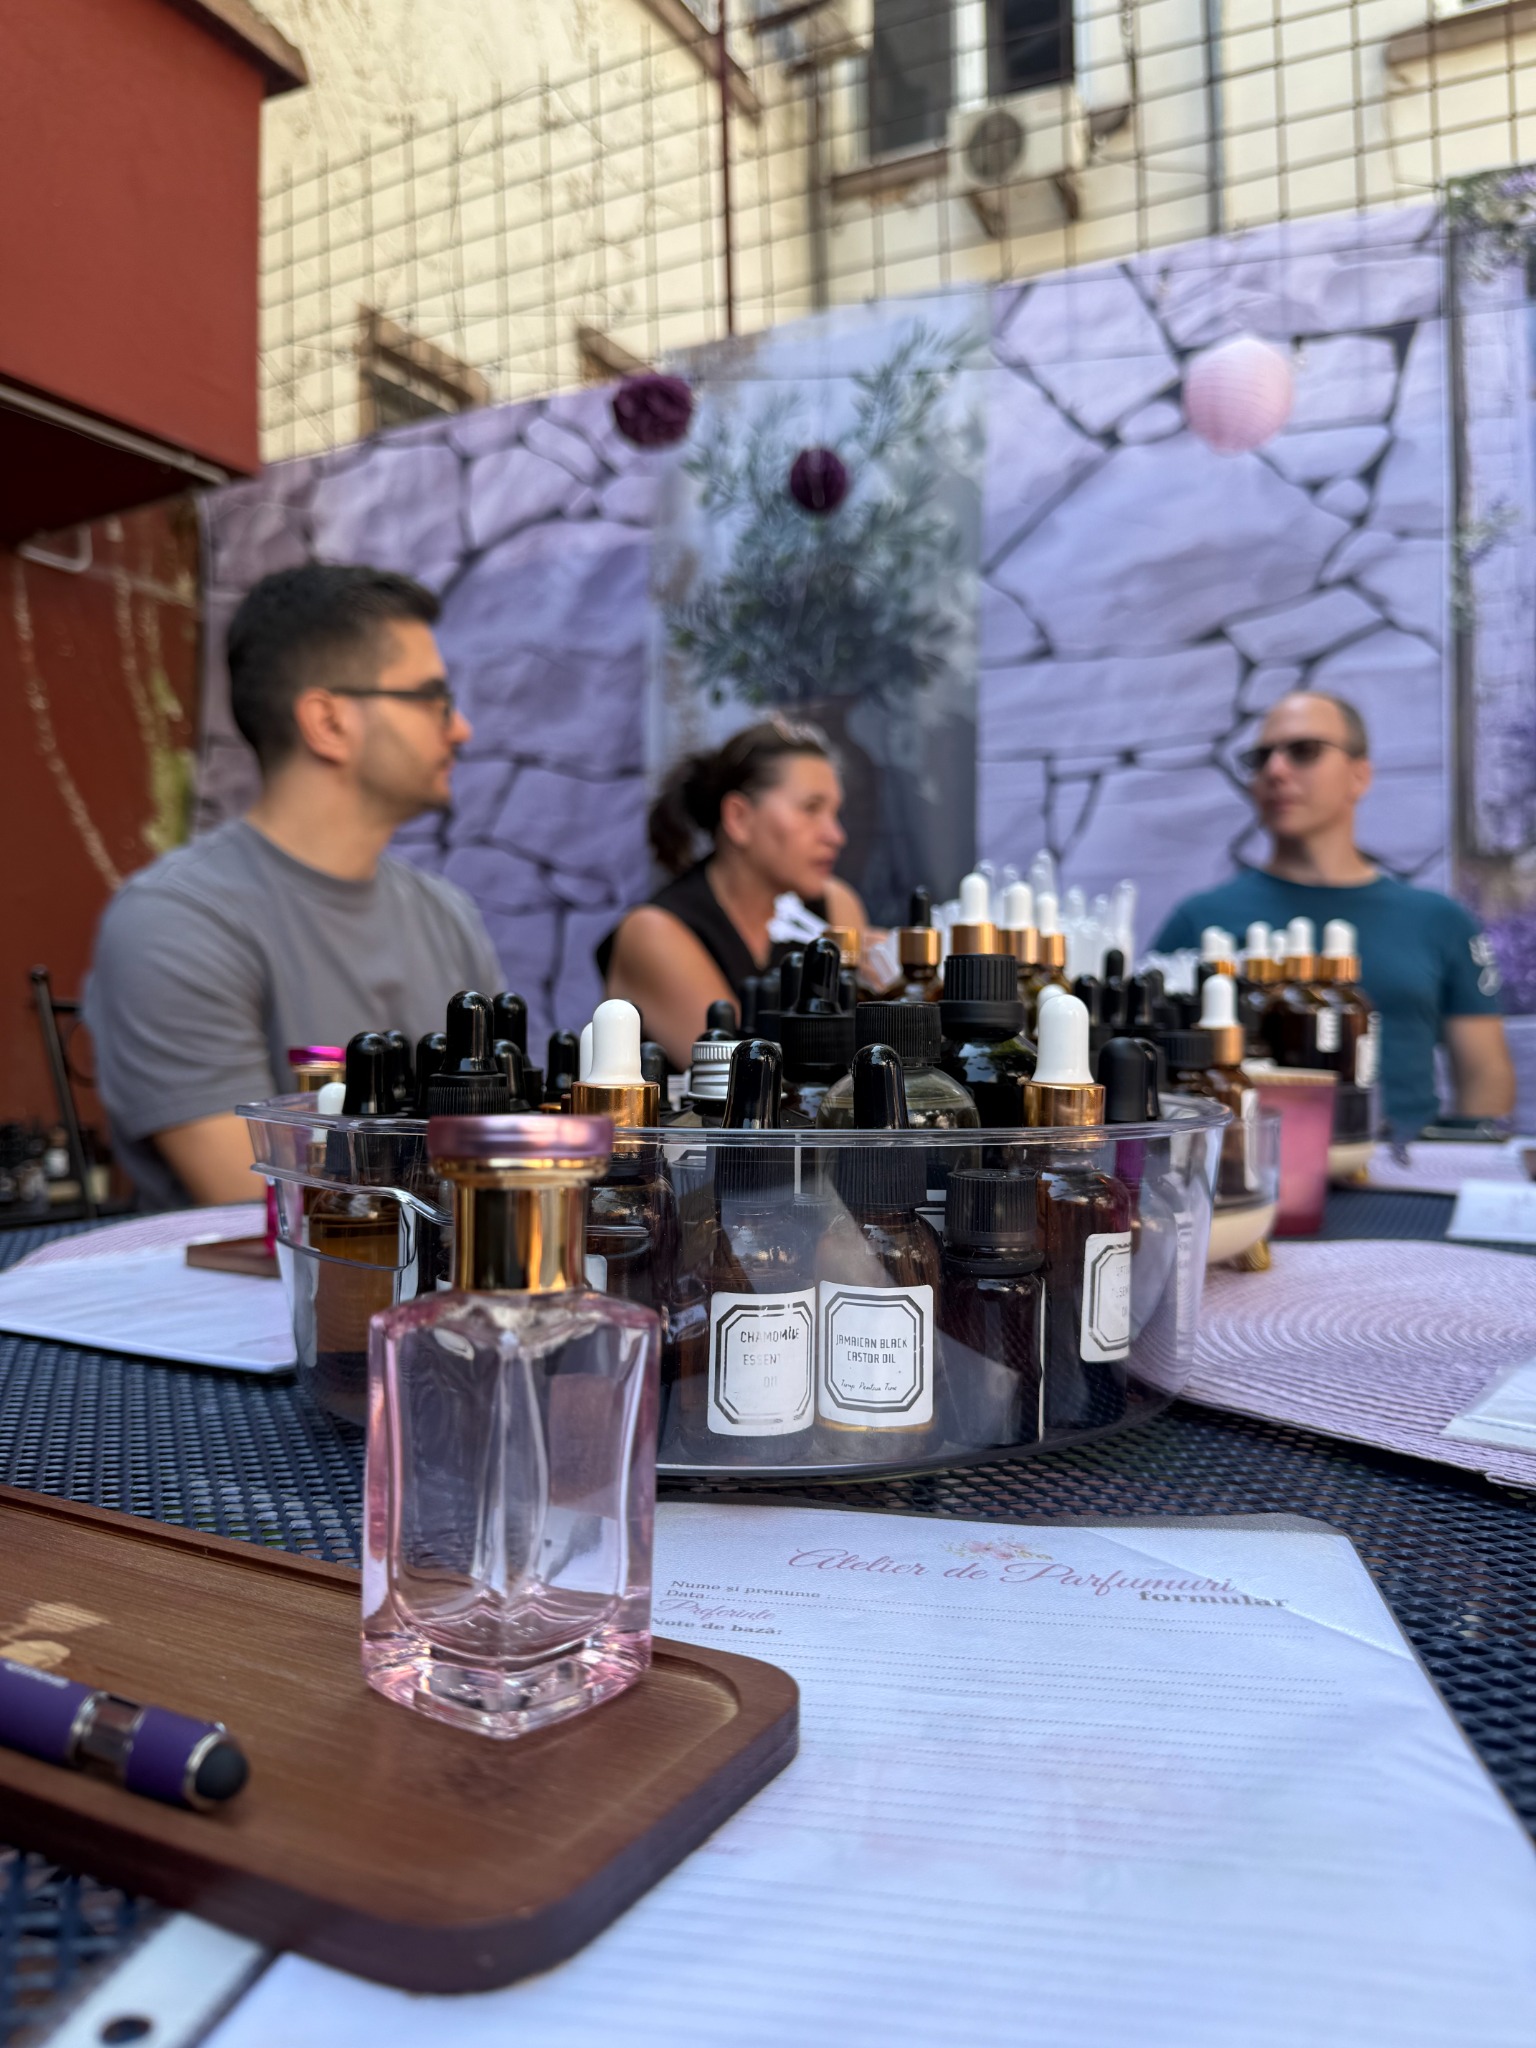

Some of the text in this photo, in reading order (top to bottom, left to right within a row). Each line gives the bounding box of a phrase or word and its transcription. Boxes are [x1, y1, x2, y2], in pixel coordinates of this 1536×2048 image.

[836, 1334, 908, 1349] JAMAICAN BLACK
[847, 1351, 896, 1364] CASTOR OIL
[788, 1548, 1236, 1596] Atelier de Parfumuri
[671, 1580, 721, 1590] Nume
[744, 1587, 821, 1599] prenume
[1138, 1590, 1288, 1607] formular
[701, 1622, 725, 1630] de
